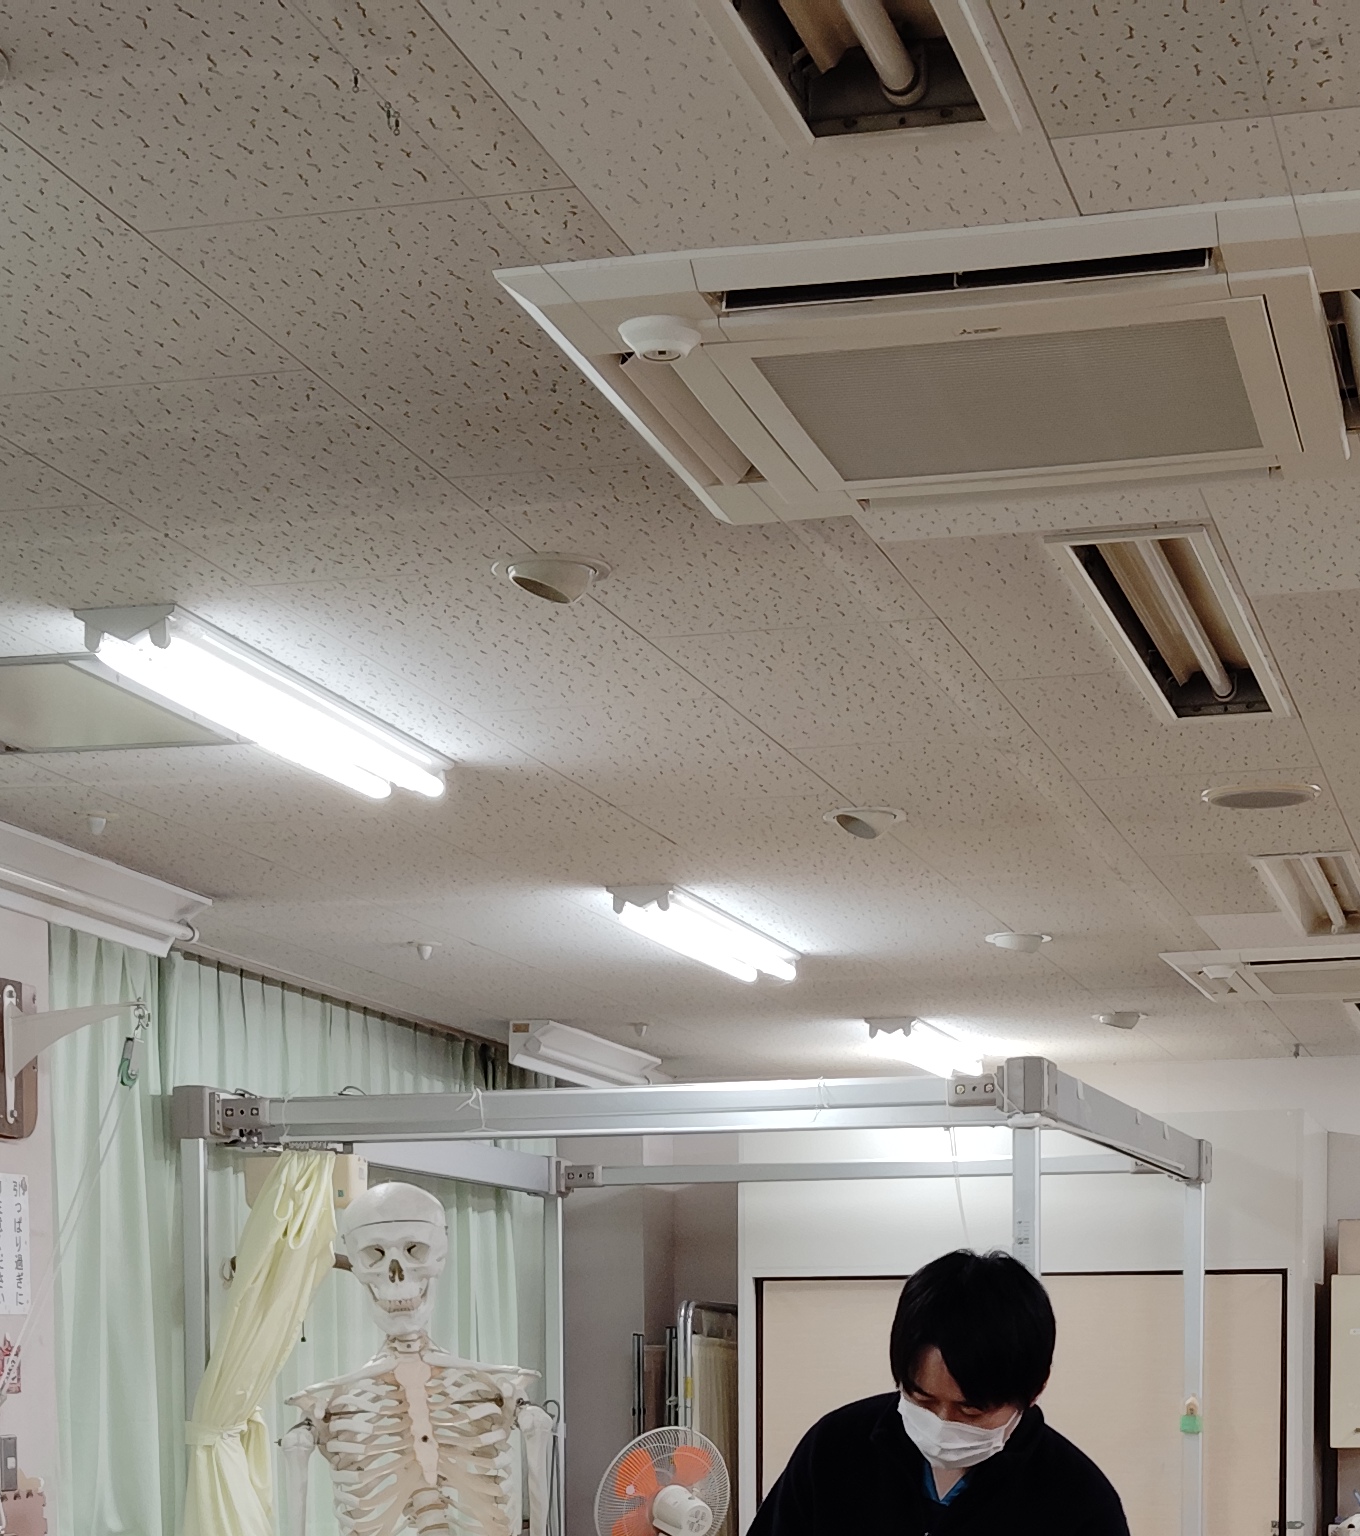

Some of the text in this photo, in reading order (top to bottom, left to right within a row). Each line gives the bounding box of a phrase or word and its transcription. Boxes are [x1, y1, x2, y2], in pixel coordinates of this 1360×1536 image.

[12, 1179, 24, 1307] 引っぱり過ぎに
